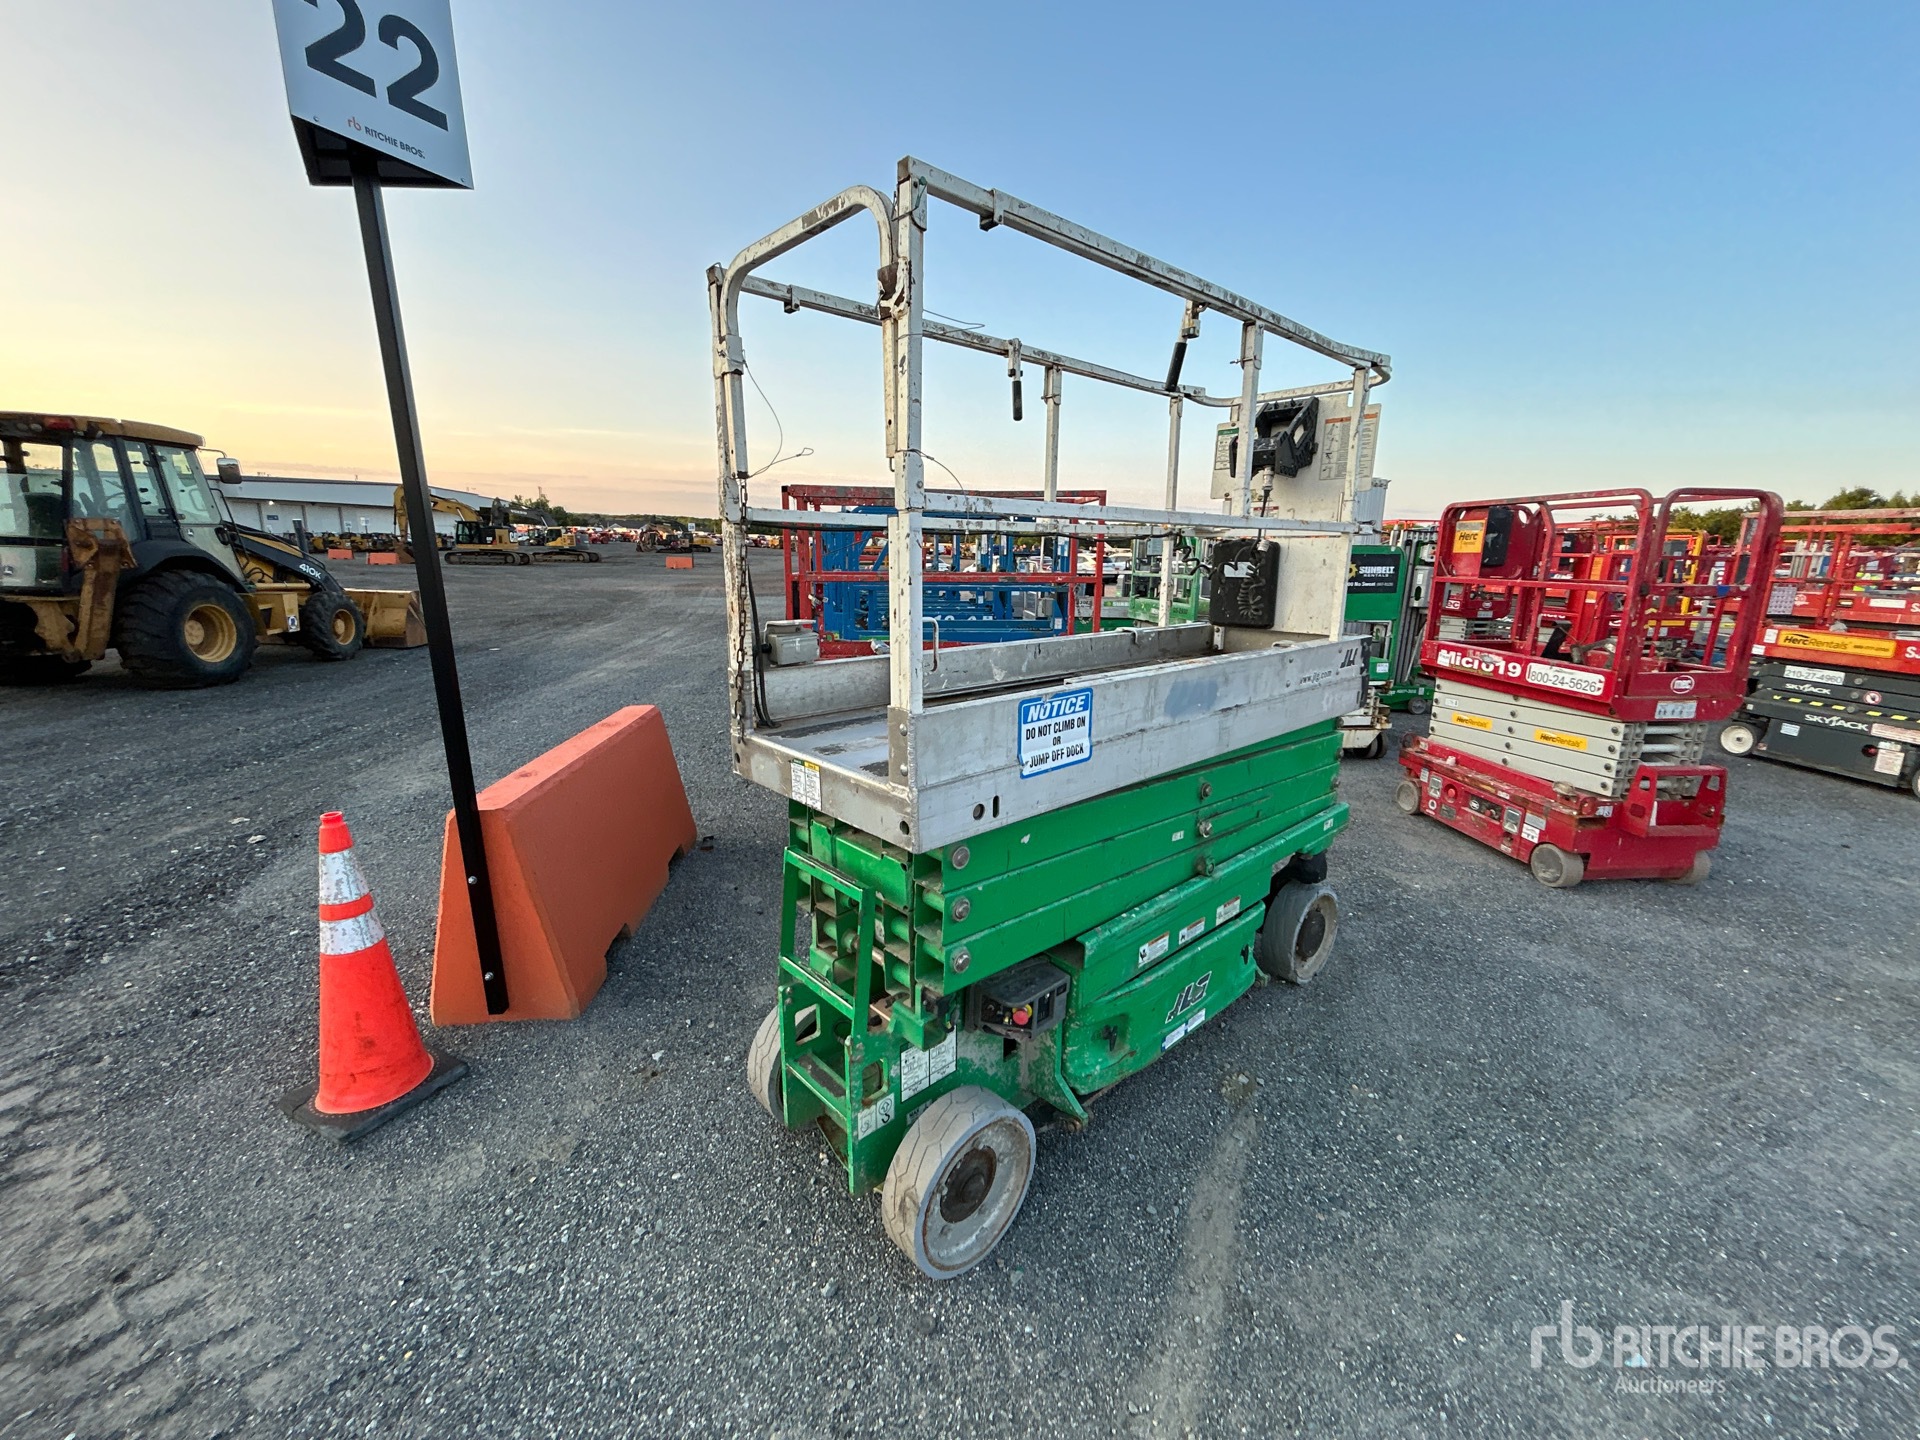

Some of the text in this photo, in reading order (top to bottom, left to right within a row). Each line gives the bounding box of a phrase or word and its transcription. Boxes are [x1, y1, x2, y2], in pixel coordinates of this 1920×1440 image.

[301, 0, 449, 132] 22
[364, 126, 399, 147] RITCHIE
[399, 141, 426, 159] BROS.
[1459, 532, 1479, 541] Herc
[299, 563, 322, 580] 410K
[1358, 565, 1396, 574] SUNBELT
[1530, 669, 1598, 693] 800-24-5626
[1784, 683, 1831, 695] SKYJACK
[1026, 695, 1086, 723] NOTICE
[1026, 716, 1086, 740] DO NOT CLIMB ON
[1804, 713, 1869, 732] SKYJACK
[1052, 735, 1062, 746] OR
[1029, 743, 1084, 768] JUMP OFF DOCK
